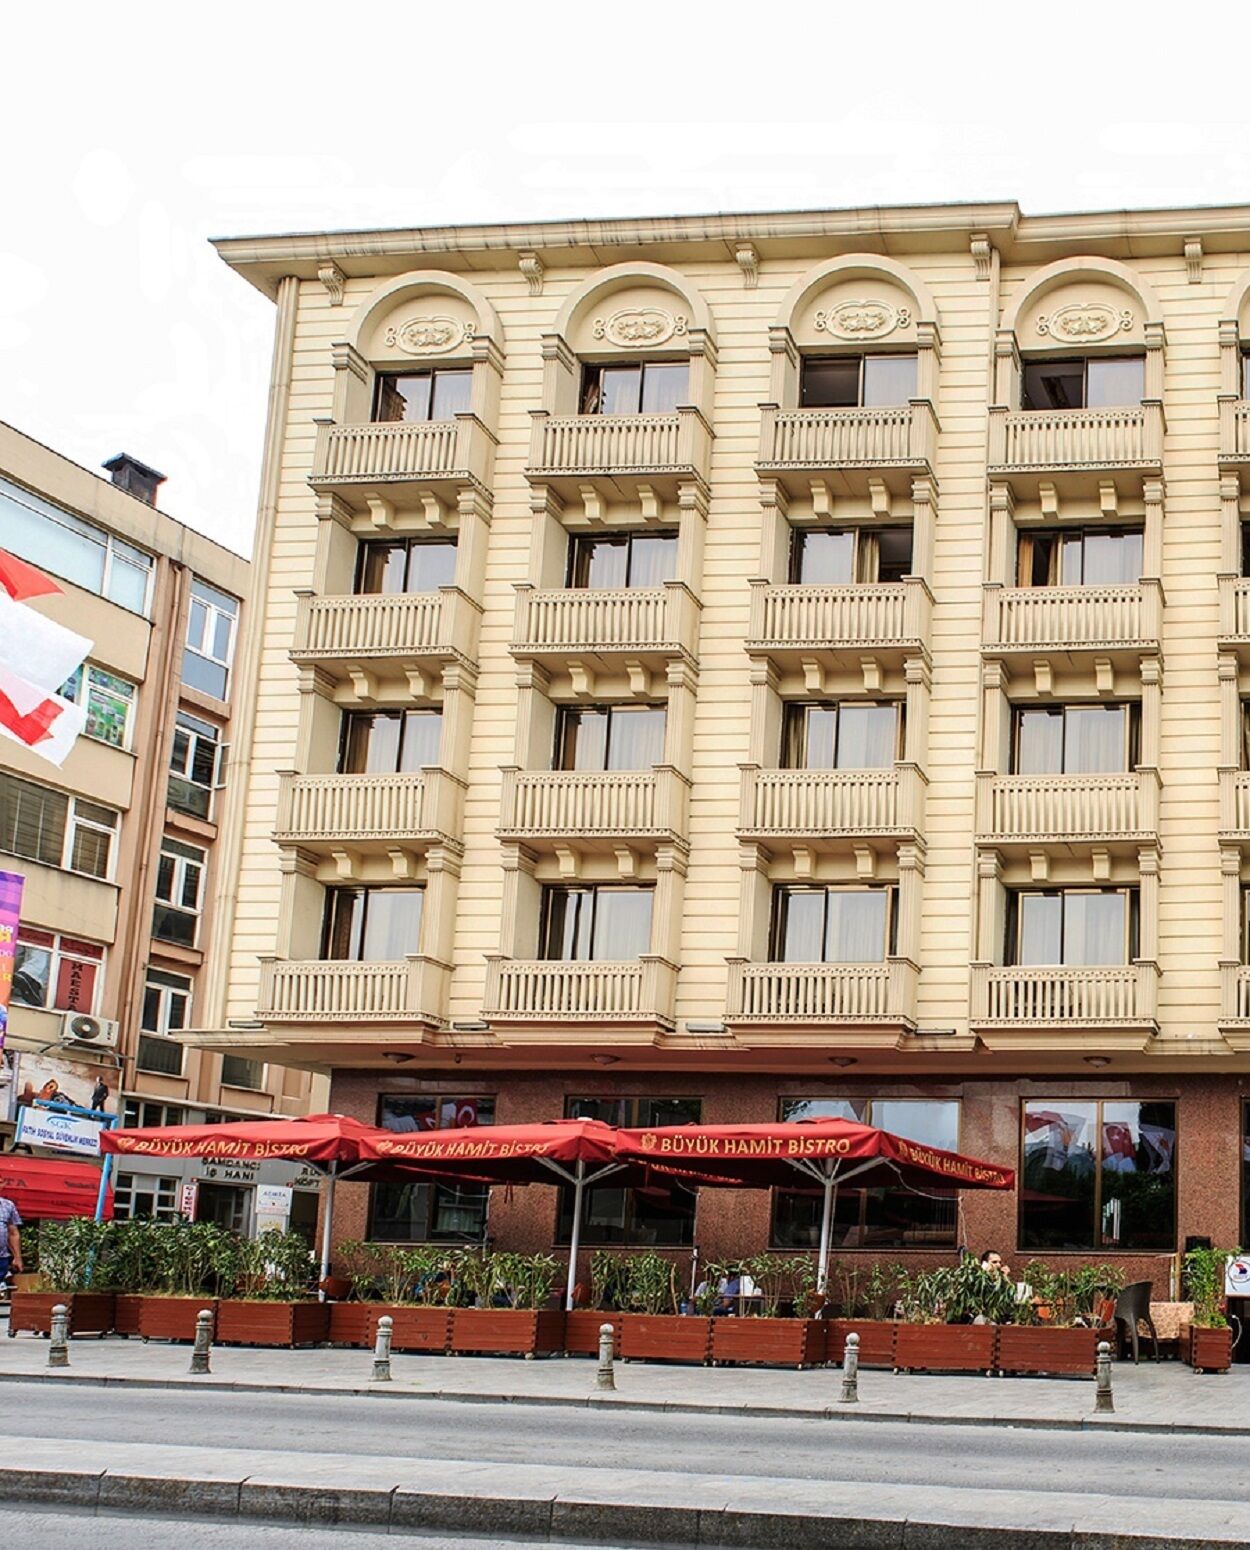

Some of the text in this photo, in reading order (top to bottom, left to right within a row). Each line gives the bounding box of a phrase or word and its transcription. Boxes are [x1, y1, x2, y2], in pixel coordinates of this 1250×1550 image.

[134, 1137, 309, 1156] BÜYÜK HAMİT BİSTRO
[390, 1140, 444, 1158] BÜYÜK
[446, 1139, 499, 1157] HAMİT
[660, 1135, 851, 1154] BÜYÜK HAMİT BİSTRO
[909, 1147, 942, 1171] BÜYÜK
[943, 1157, 974, 1178] HAMİT
[224, 1170, 254, 1180] HANI
